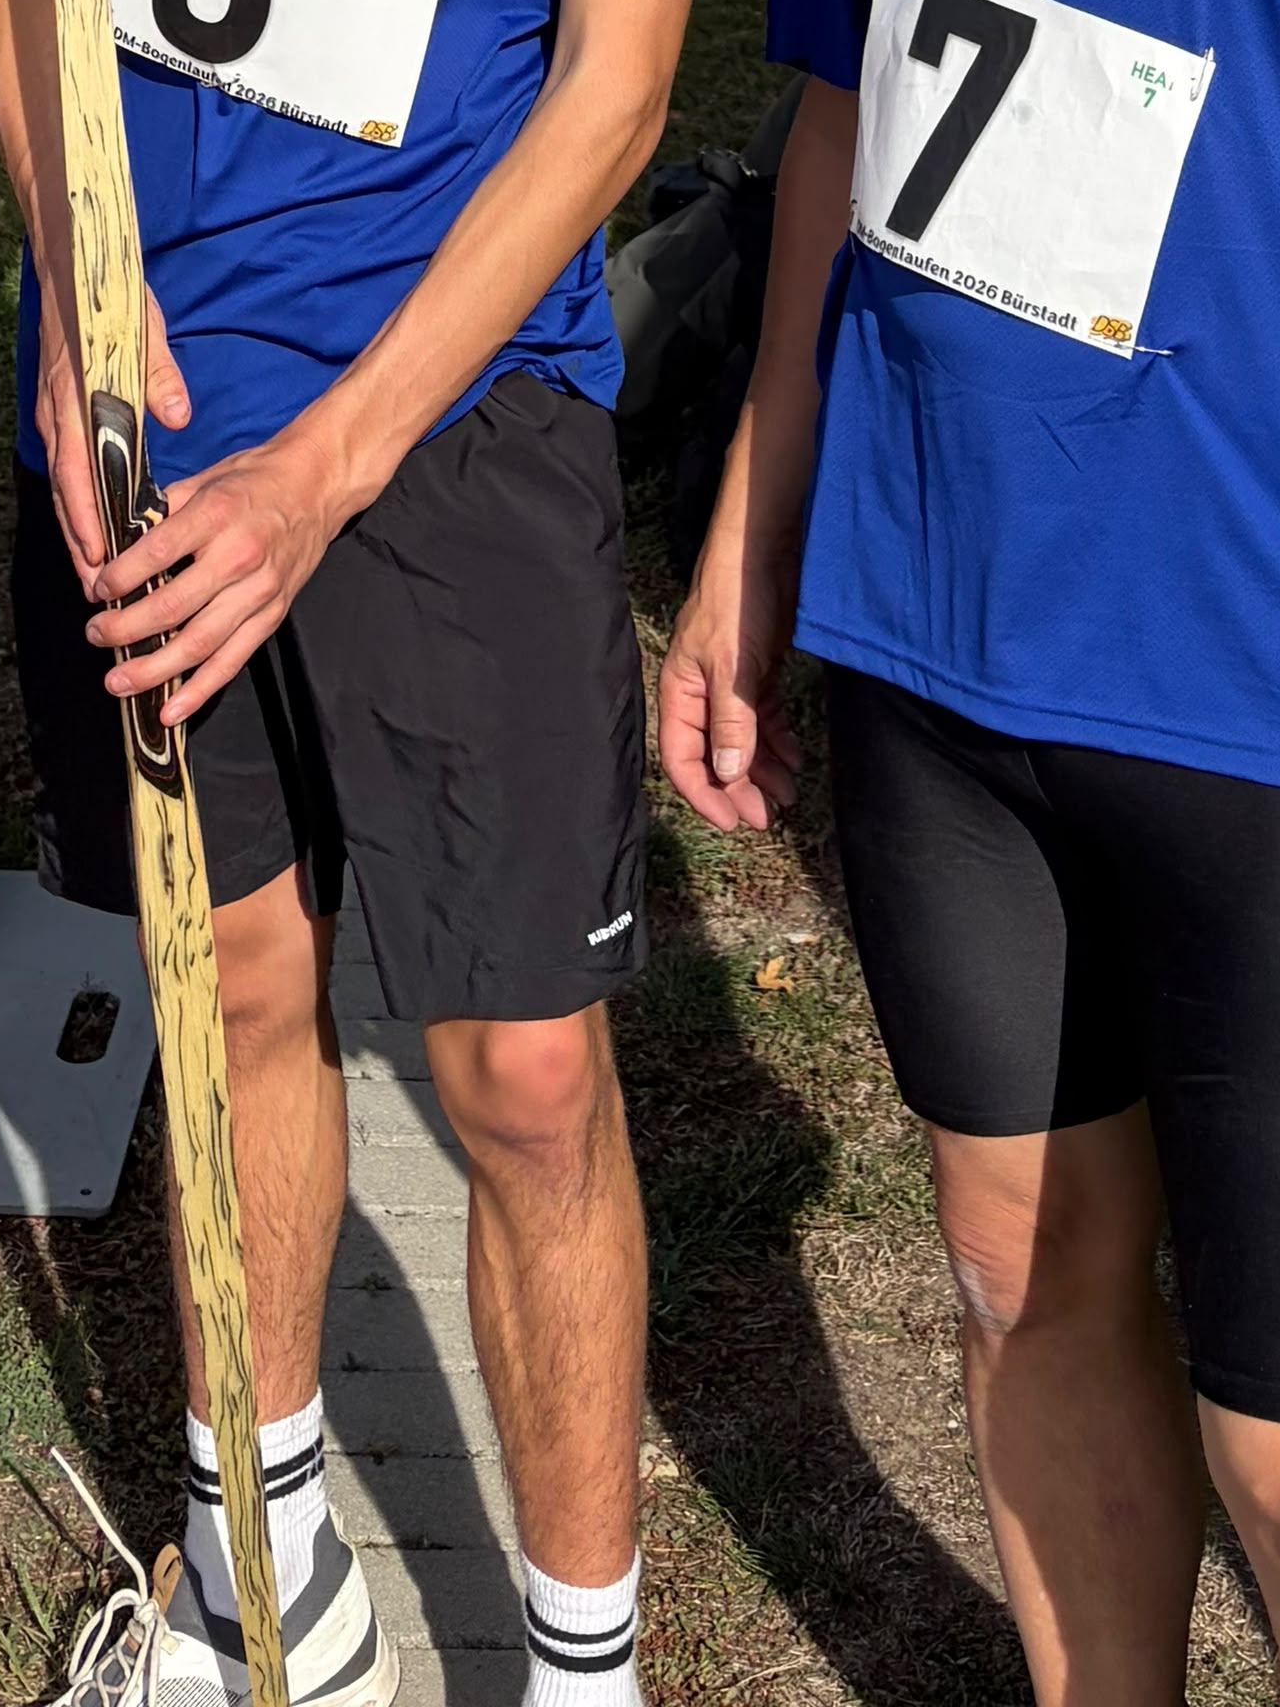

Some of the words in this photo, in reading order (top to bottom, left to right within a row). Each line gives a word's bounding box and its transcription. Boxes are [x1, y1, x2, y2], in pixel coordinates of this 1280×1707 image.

[235, 83, 277, 109] 2026
[279, 100, 349, 134] Bürstadt
[1144, 87, 1157, 108] 7
[953, 271, 998, 300] 2026
[1001, 289, 1078, 332] Bürstadt
